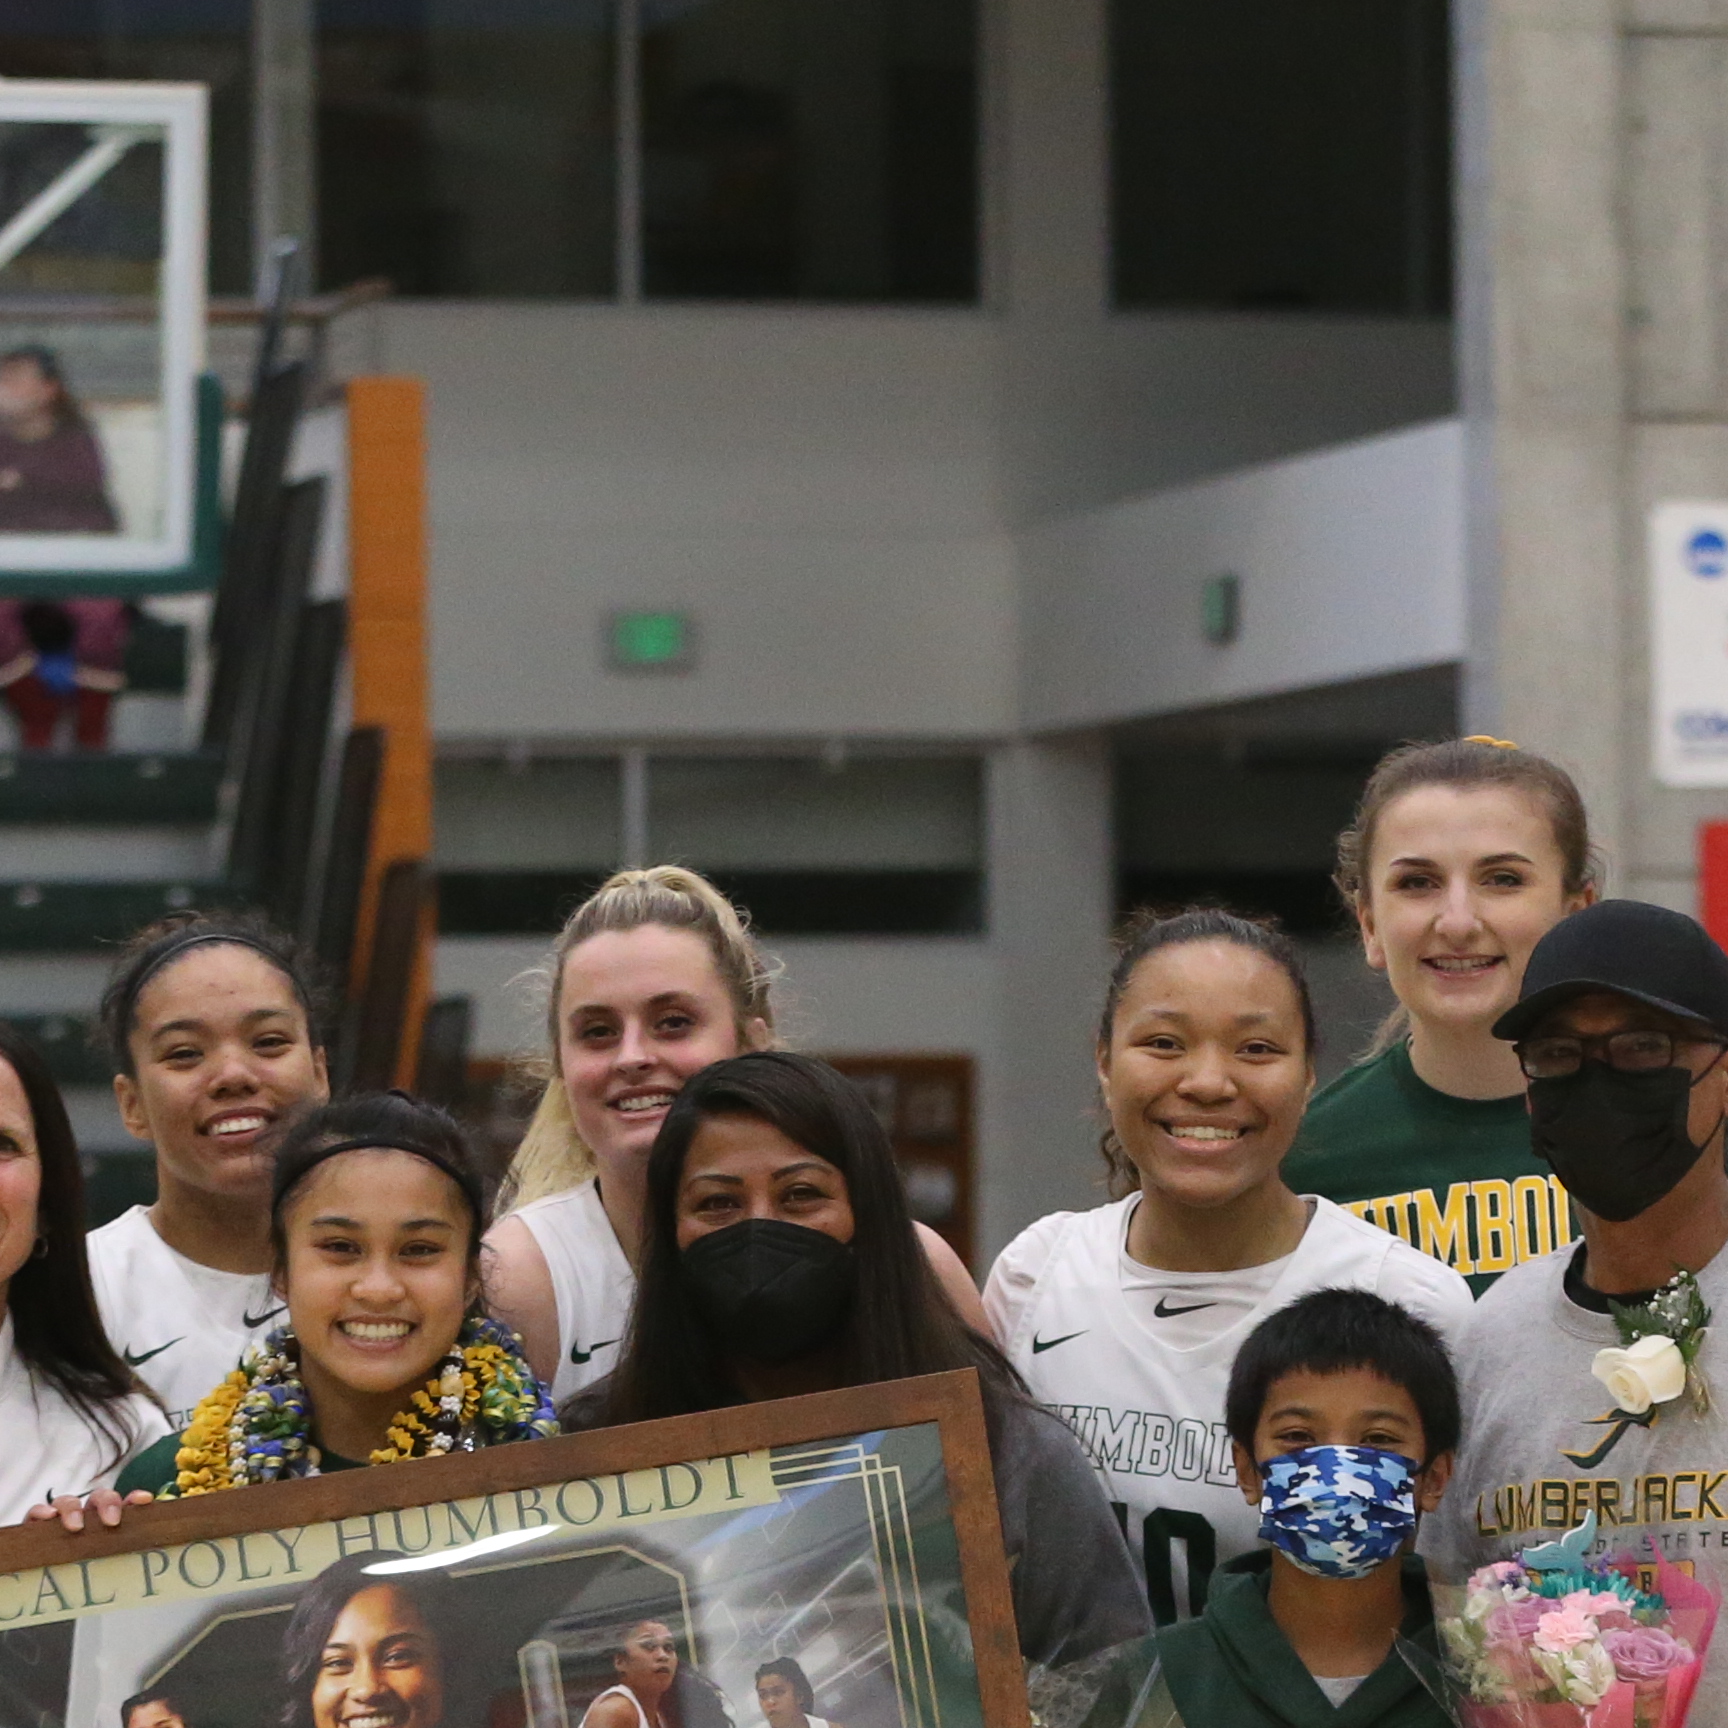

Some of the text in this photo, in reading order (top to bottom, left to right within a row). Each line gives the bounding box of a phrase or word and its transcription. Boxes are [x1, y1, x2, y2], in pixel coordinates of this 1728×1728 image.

[1338, 1174, 1571, 1276] UMBOL
[1043, 1404, 1239, 1488] UMBOL
[141, 1525, 305, 1598] POLY
[335, 1451, 751, 1558] HUMBOLDT
